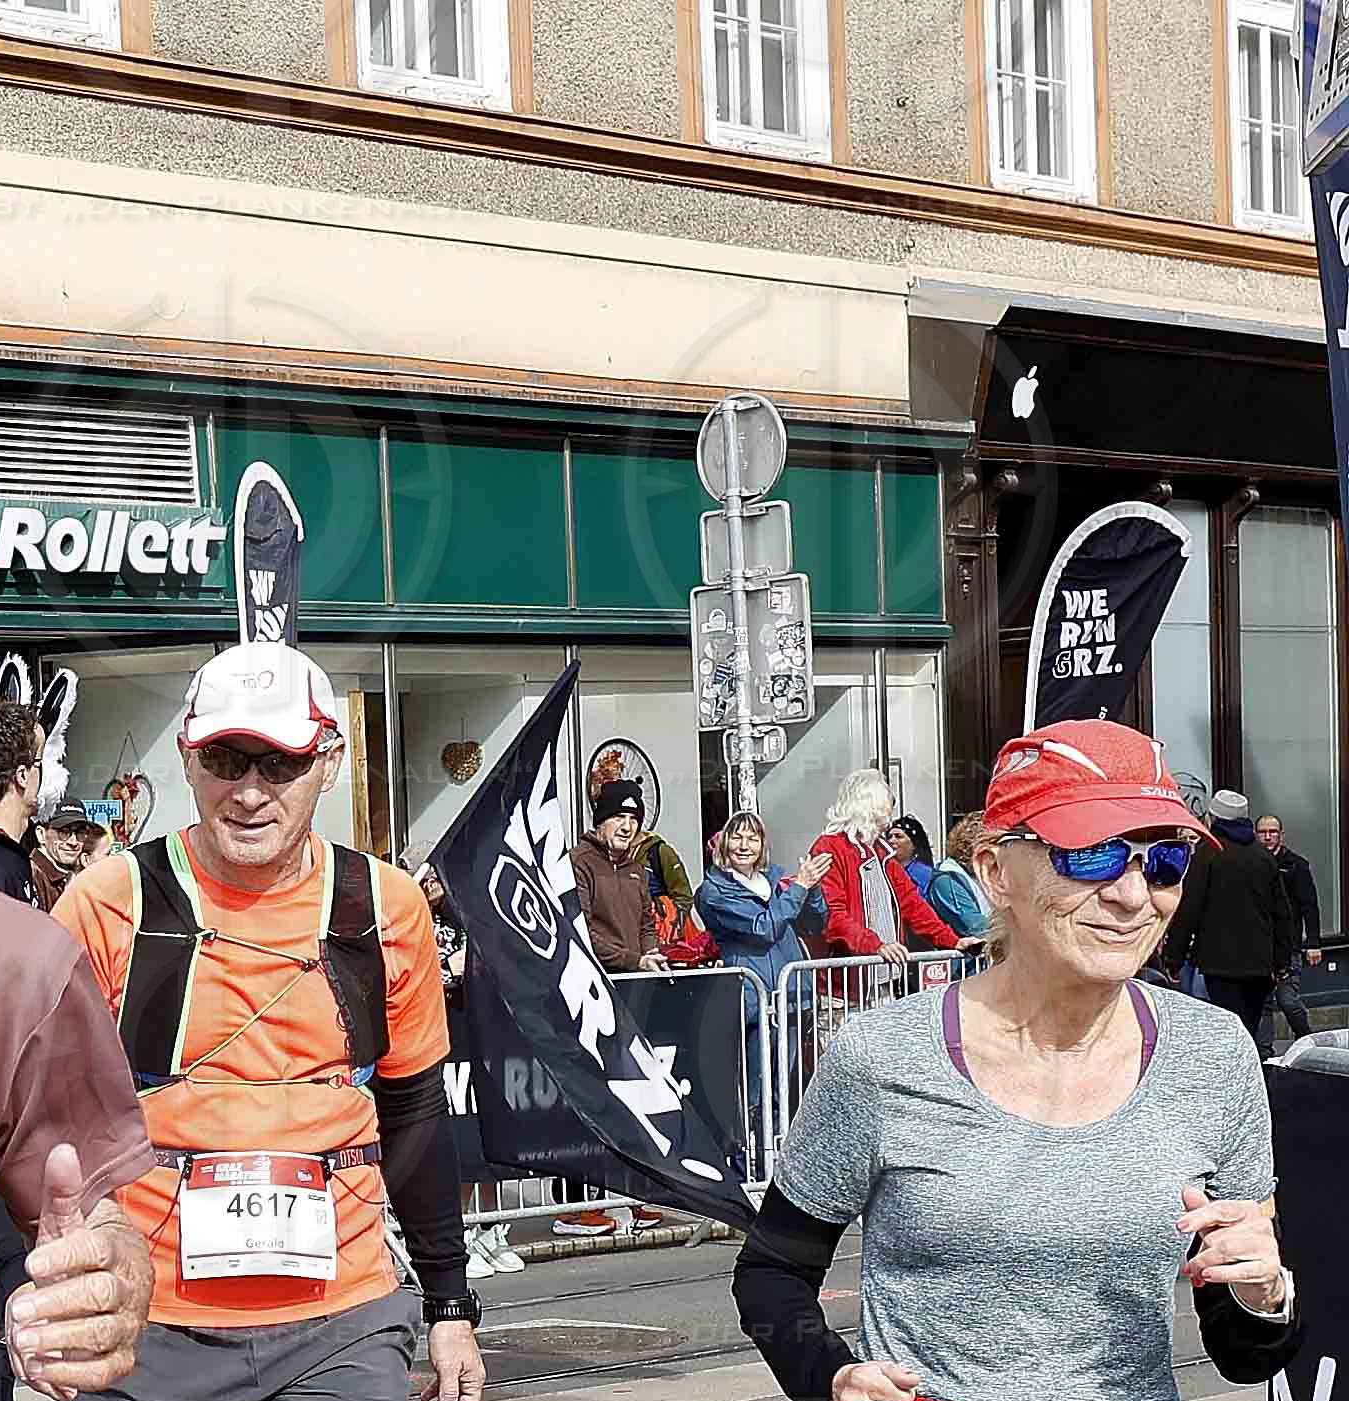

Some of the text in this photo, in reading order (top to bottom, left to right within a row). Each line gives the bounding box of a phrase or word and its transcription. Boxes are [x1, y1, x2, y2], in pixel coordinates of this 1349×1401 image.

[1062, 589, 1109, 619] WE
[1053, 645, 1124, 679] GRZ.
[227, 1193, 297, 1219] 4617
